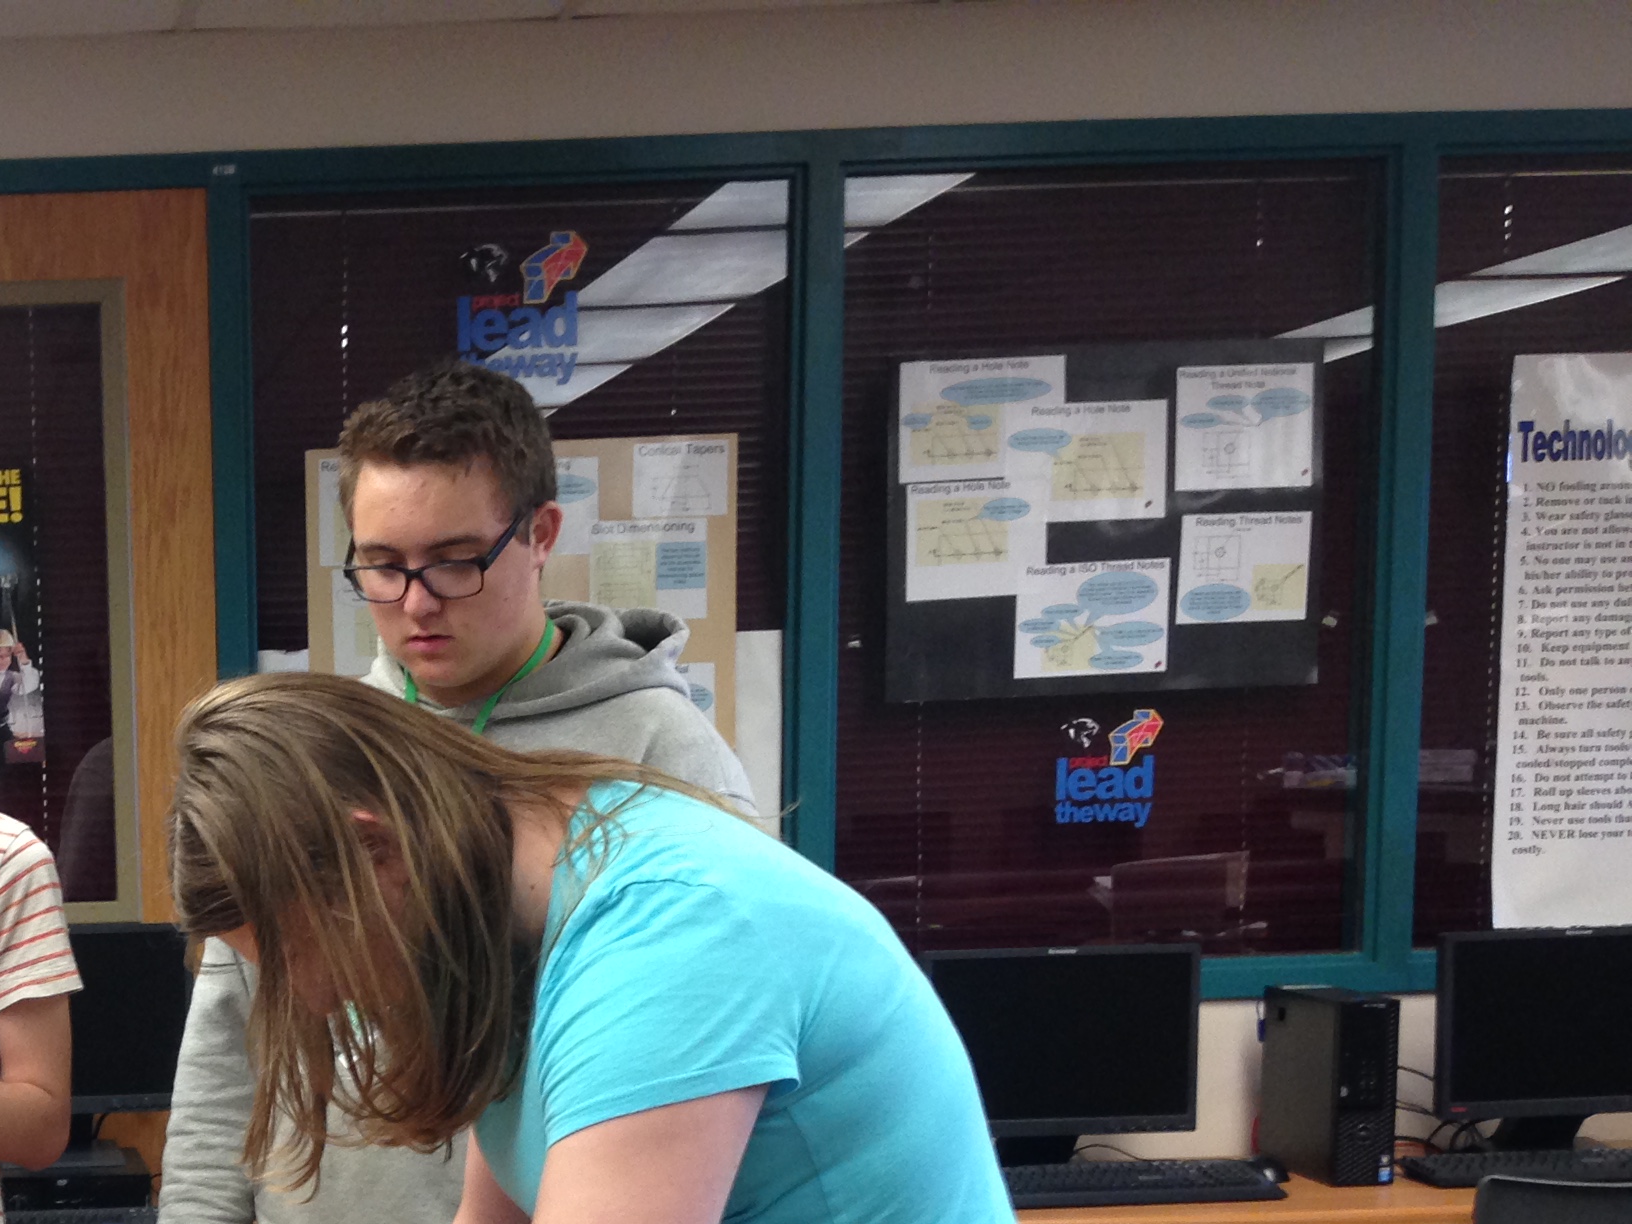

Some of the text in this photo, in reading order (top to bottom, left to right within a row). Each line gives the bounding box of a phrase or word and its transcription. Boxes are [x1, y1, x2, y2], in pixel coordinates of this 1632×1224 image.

[457, 291, 578, 352] lead
[686, 443, 725, 456] Tapers
[1026, 565, 1067, 576] Reading
[1531, 629, 1568, 639] Report
[1572, 629, 1590, 639] any
[1594, 628, 1617, 638] type
[1541, 643, 1569, 654] Keep
[1572, 642, 1630, 654] equipment
[1539, 686, 1565, 697] Only
[1591, 687, 1626, 697] person
[1539, 701, 1583, 710] Observe
[1587, 700, 1602, 709] the
[1519, 716, 1568, 725] machine.
[1537, 729, 1551, 739] Be
[1581, 728, 1594, 738] all
[1597, 728, 1626, 739] safety
[1537, 744, 1576, 755] Always
[1579, 744, 1601, 752] turn
[1056, 755, 1154, 800] lead
[1535, 773, 1550, 782] Do
[1553, 774, 1571, 782] not
[1574, 773, 1614, 783] attempt
[1534, 787, 1556, 796] Roll
[1559, 789, 1574, 798] up
[1577, 786, 1611, 796] sleeves
[1533, 802, 1560, 812] Long
[1564, 801, 1586, 810] hair
[1589, 801, 1623, 810] should
[1533, 816, 1564, 825] Never
[1588, 815, 1612, 824] tools
[1532, 829, 1575, 839] NEVER
[1579, 829, 1599, 838] lose
[1601, 830, 1623, 840] your
[1512, 845, 1546, 856] costly.
